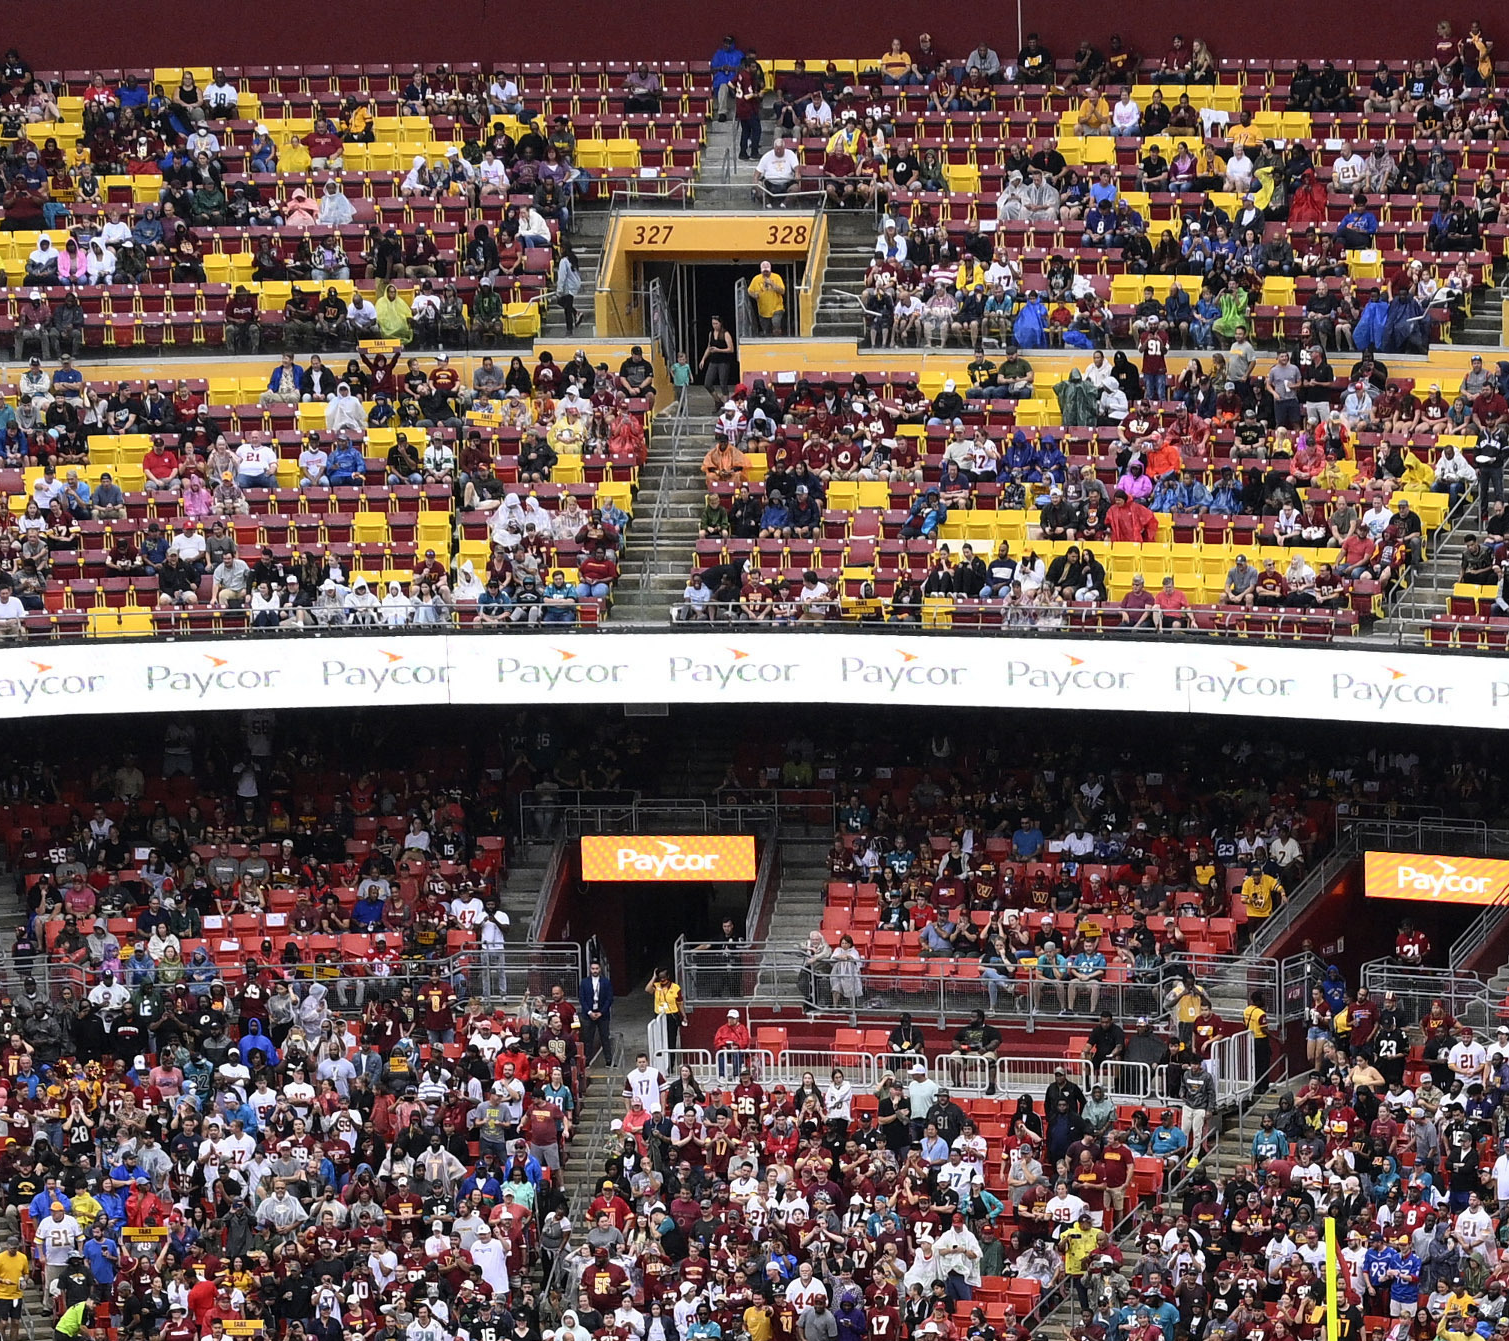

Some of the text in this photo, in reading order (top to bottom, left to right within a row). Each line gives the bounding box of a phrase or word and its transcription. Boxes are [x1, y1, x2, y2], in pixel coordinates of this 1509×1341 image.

[633, 226, 673, 244] 327
[766, 226, 807, 244] 328
[244, 453, 259, 466] 21
[148, 667, 279, 698] Paycor
[324, 661, 458, 692] Paycor
[499, 660, 628, 689] Paycor
[671, 659, 799, 689] Paycor
[843, 659, 967, 689] Paycor
[1007, 662, 1132, 695] Paycor
[1177, 668, 1293, 698] Paycor
[1333, 671, 1450, 708] Paycor
[617, 848, 720, 877] Paycor
[1397, 866, 1492, 897] Paycor
